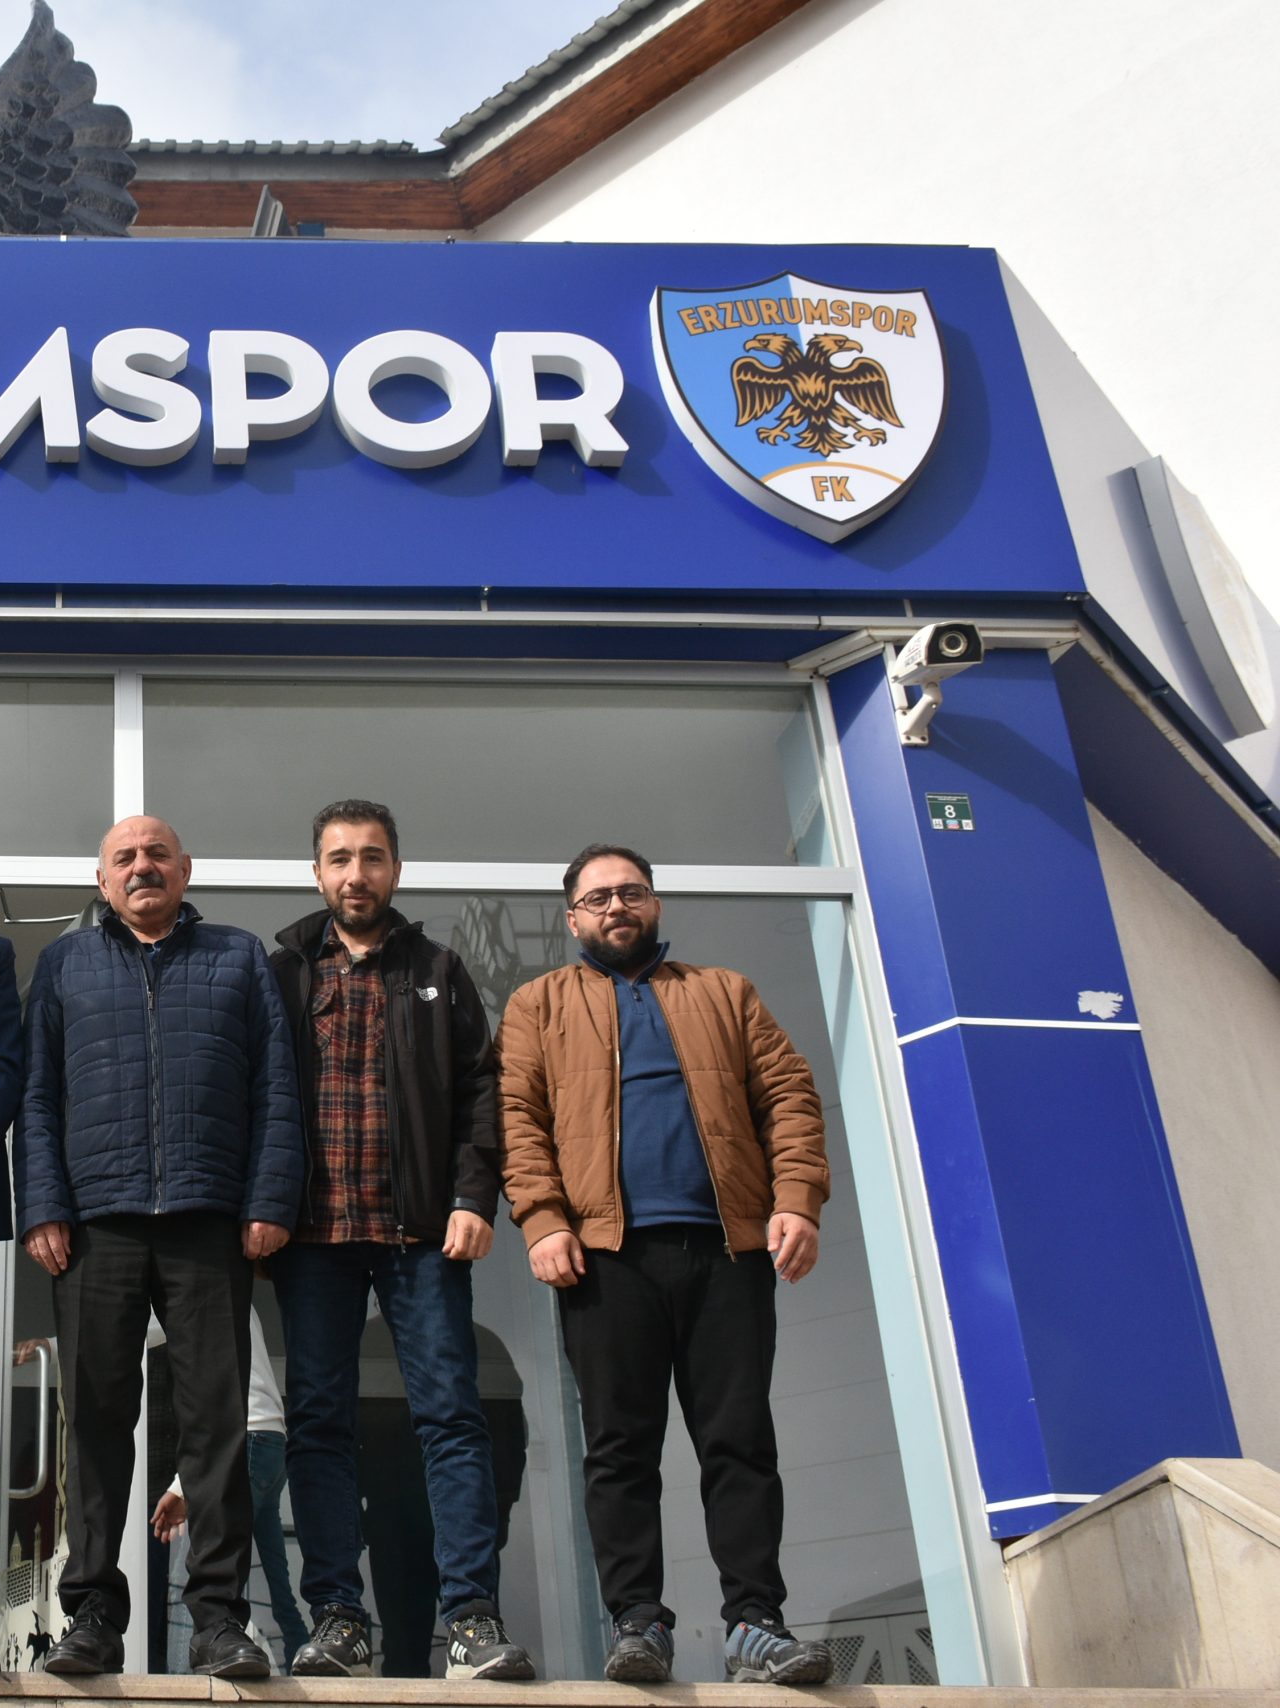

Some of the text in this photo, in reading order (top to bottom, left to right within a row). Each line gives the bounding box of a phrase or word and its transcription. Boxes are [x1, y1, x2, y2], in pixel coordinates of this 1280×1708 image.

[677, 298, 917, 337] ERZURUMSPOR
[811, 475, 855, 502] FK
[944, 804, 956, 818] 8
